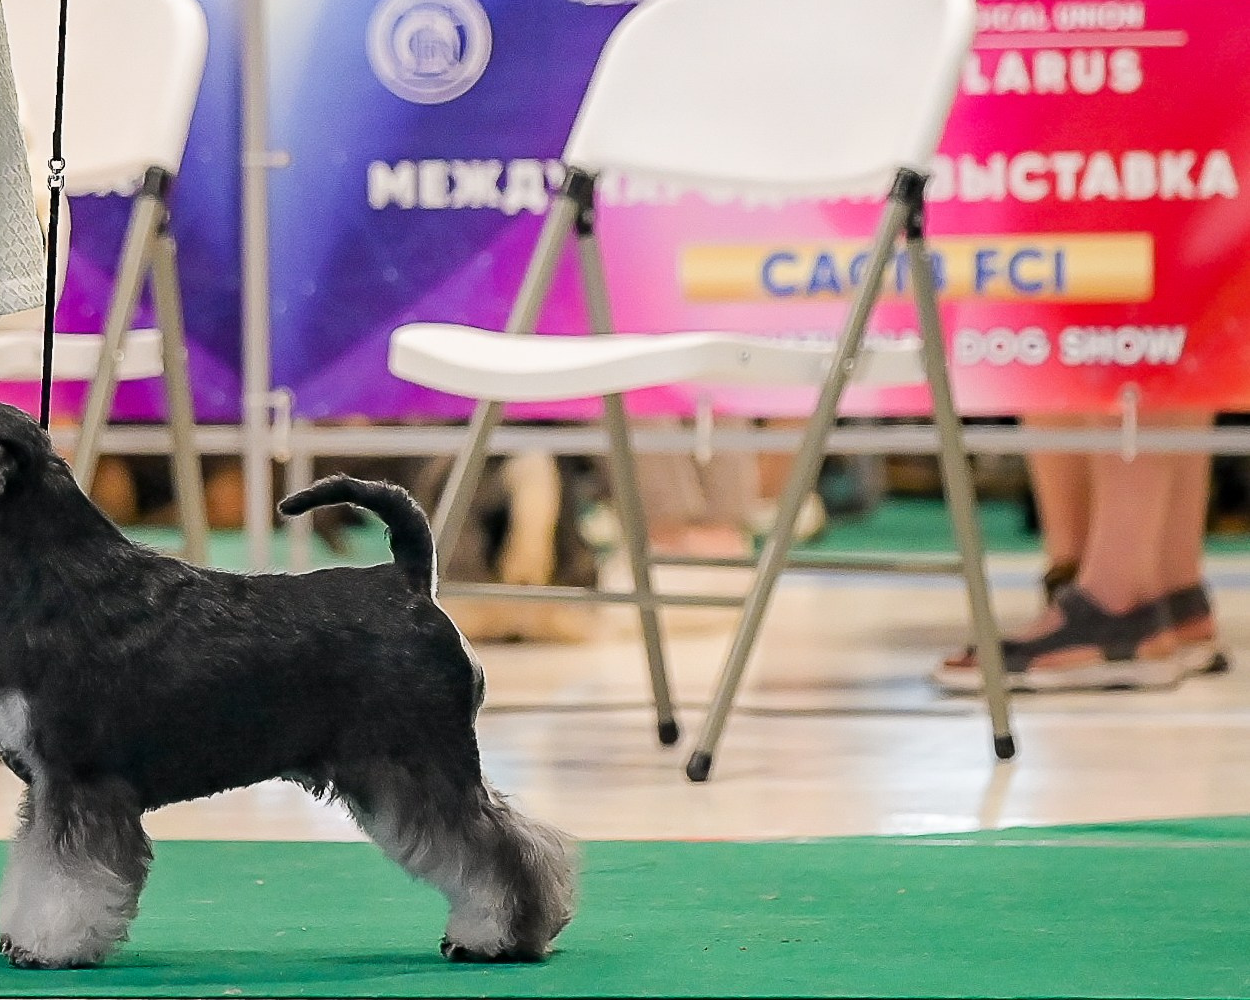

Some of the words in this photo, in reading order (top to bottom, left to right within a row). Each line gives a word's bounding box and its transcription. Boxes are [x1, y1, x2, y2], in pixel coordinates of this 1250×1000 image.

[962, 48, 1144, 95] LARUS
[973, 248, 1067, 294] FCI
[955, 327, 1050, 367] DOG
[1058, 324, 1188, 366] SHOW
